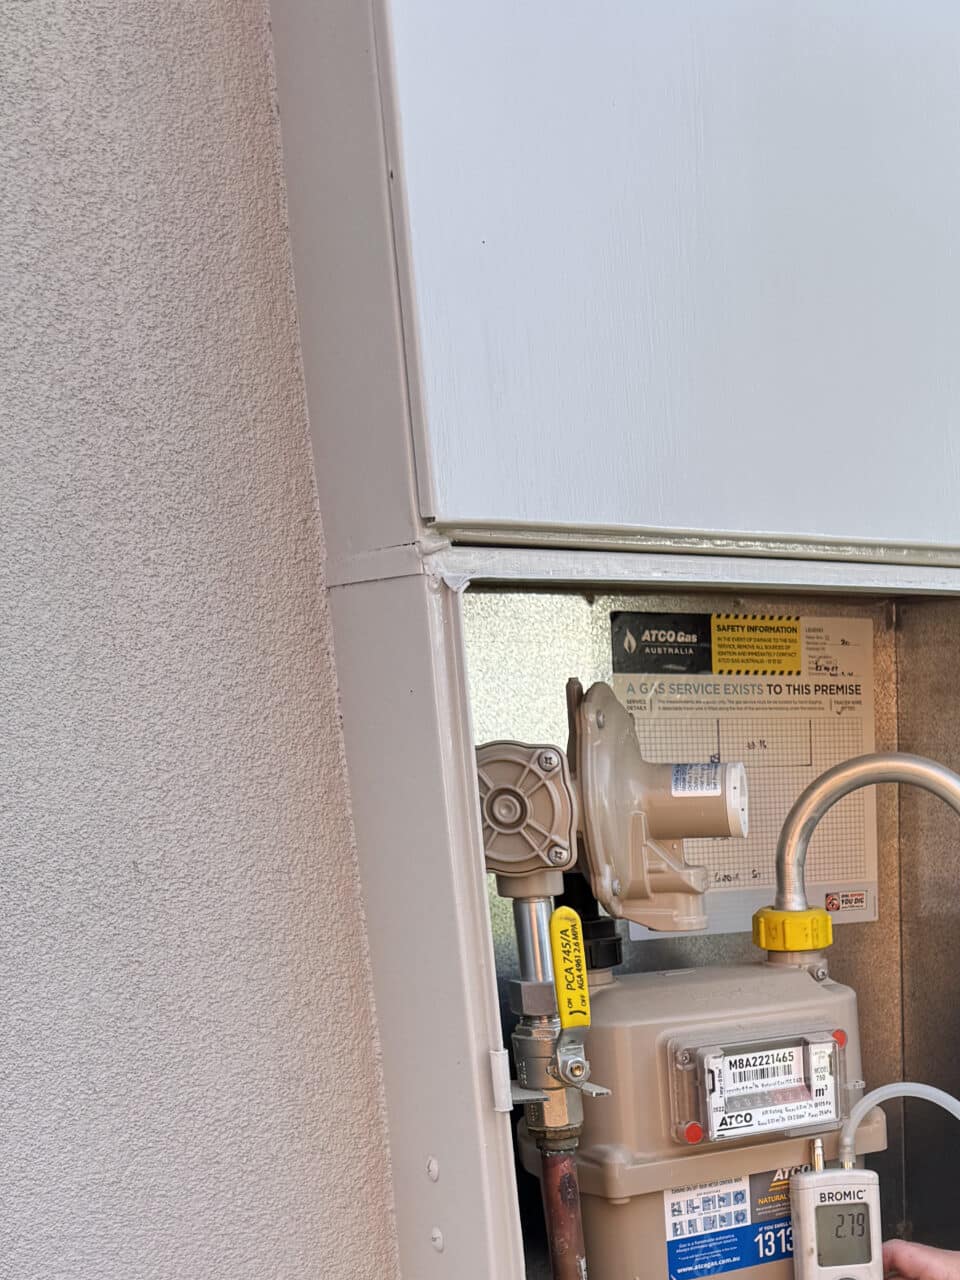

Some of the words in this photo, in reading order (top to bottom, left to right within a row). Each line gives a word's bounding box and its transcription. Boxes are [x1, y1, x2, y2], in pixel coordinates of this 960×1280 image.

[747, 625, 798, 634] INFORMATION
[641, 630, 676, 642] ATCO
[677, 631, 697, 643] Gas
[626, 684, 636, 694] A
[639, 684, 667, 695] GAS
[669, 684, 721, 695] SERVICE
[723, 684, 764, 695] EXISTS
[766, 684, 783, 695] TO
[786, 684, 812, 695] THIS
[814, 684, 862, 695] PREMISE
[570, 924, 578, 941] MPA
[559, 929, 573, 964] 745/A
[573, 941, 581, 953] 2.6
[564, 967, 576, 991] PCA
[577, 974, 585, 990] AGA
[719, 1112, 753, 1128] ATCO
[758, 1194, 787, 1204] NATURAL
[819, 1190, 864, 1203] BROMIC
